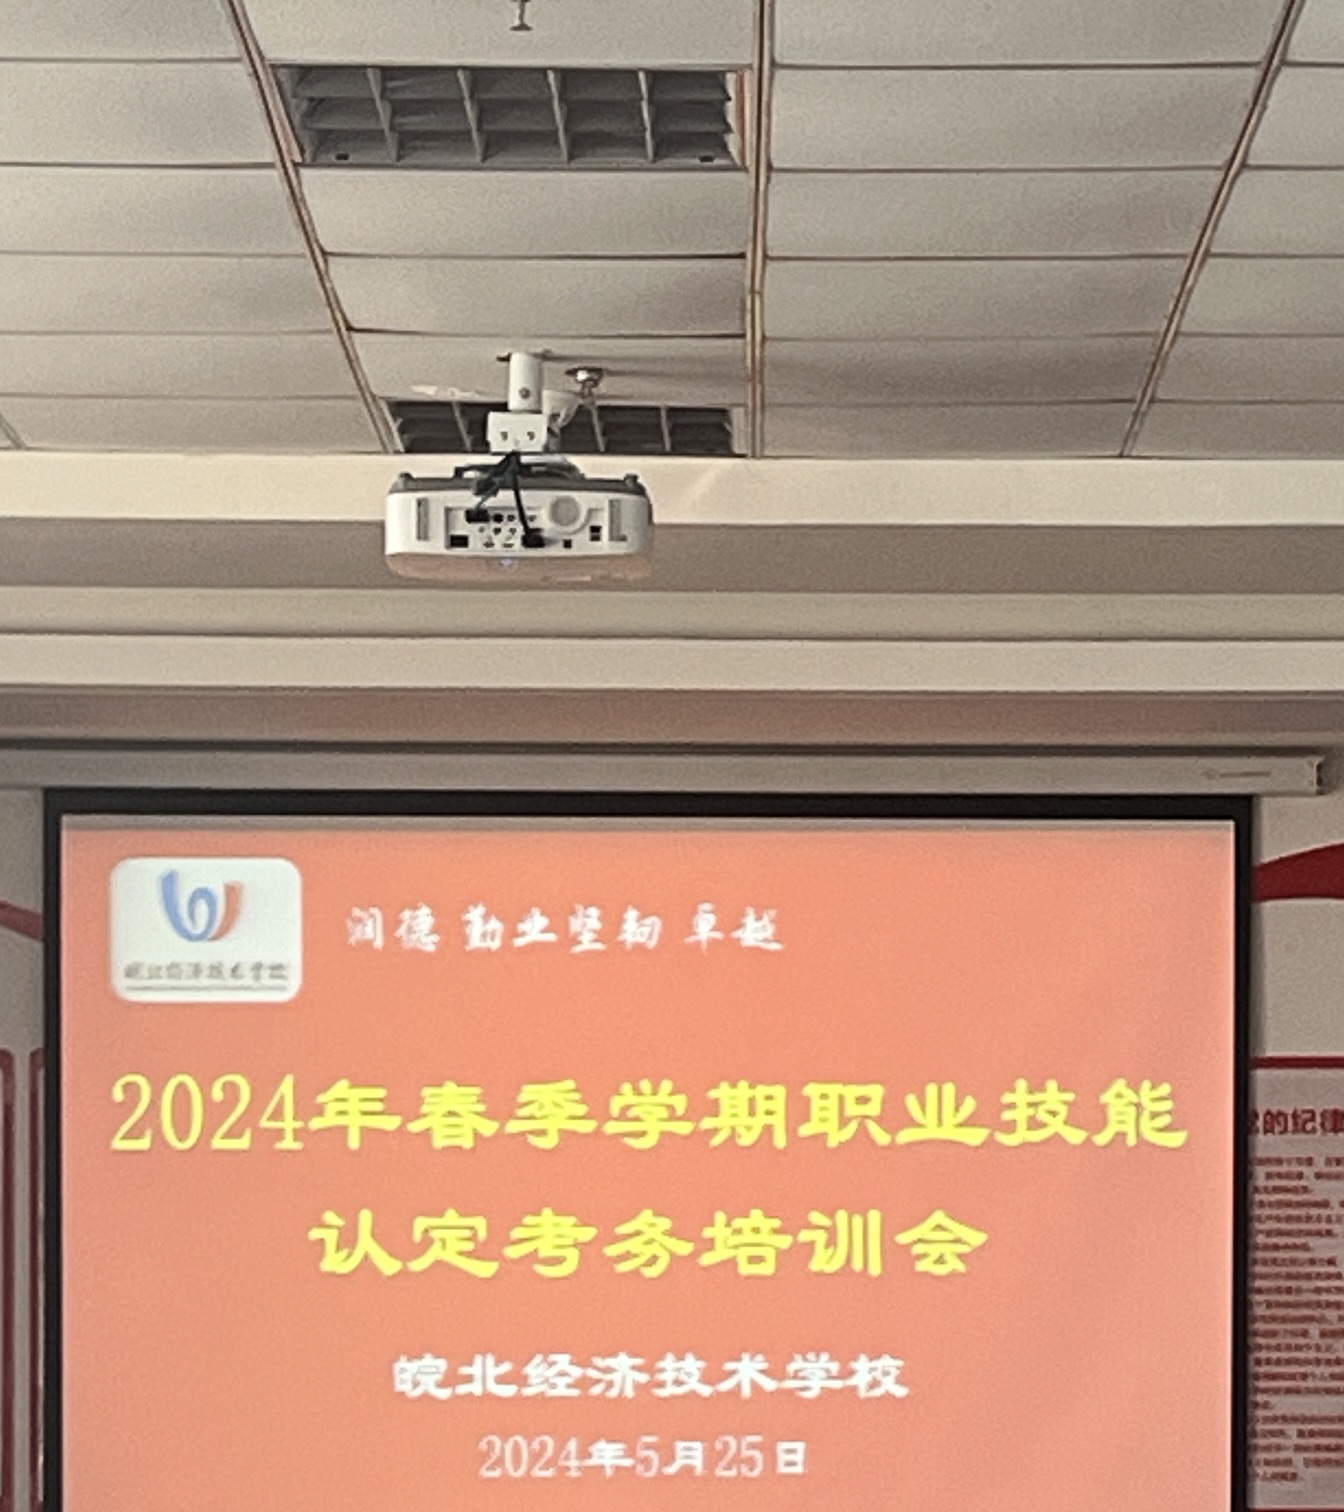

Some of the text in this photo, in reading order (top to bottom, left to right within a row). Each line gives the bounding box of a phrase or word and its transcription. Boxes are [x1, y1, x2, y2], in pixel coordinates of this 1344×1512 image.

[345, 901, 442, 953] 润德
[683, 901, 784, 952] 卓越
[110, 1073, 1188, 1152] 2024年春季学期职业技能
[306, 1207, 990, 1280] 认定考务培训会
[392, 1351, 910, 1400] 皖北经济技术学校
[478, 1434, 807, 1479] 2024年5月25日
